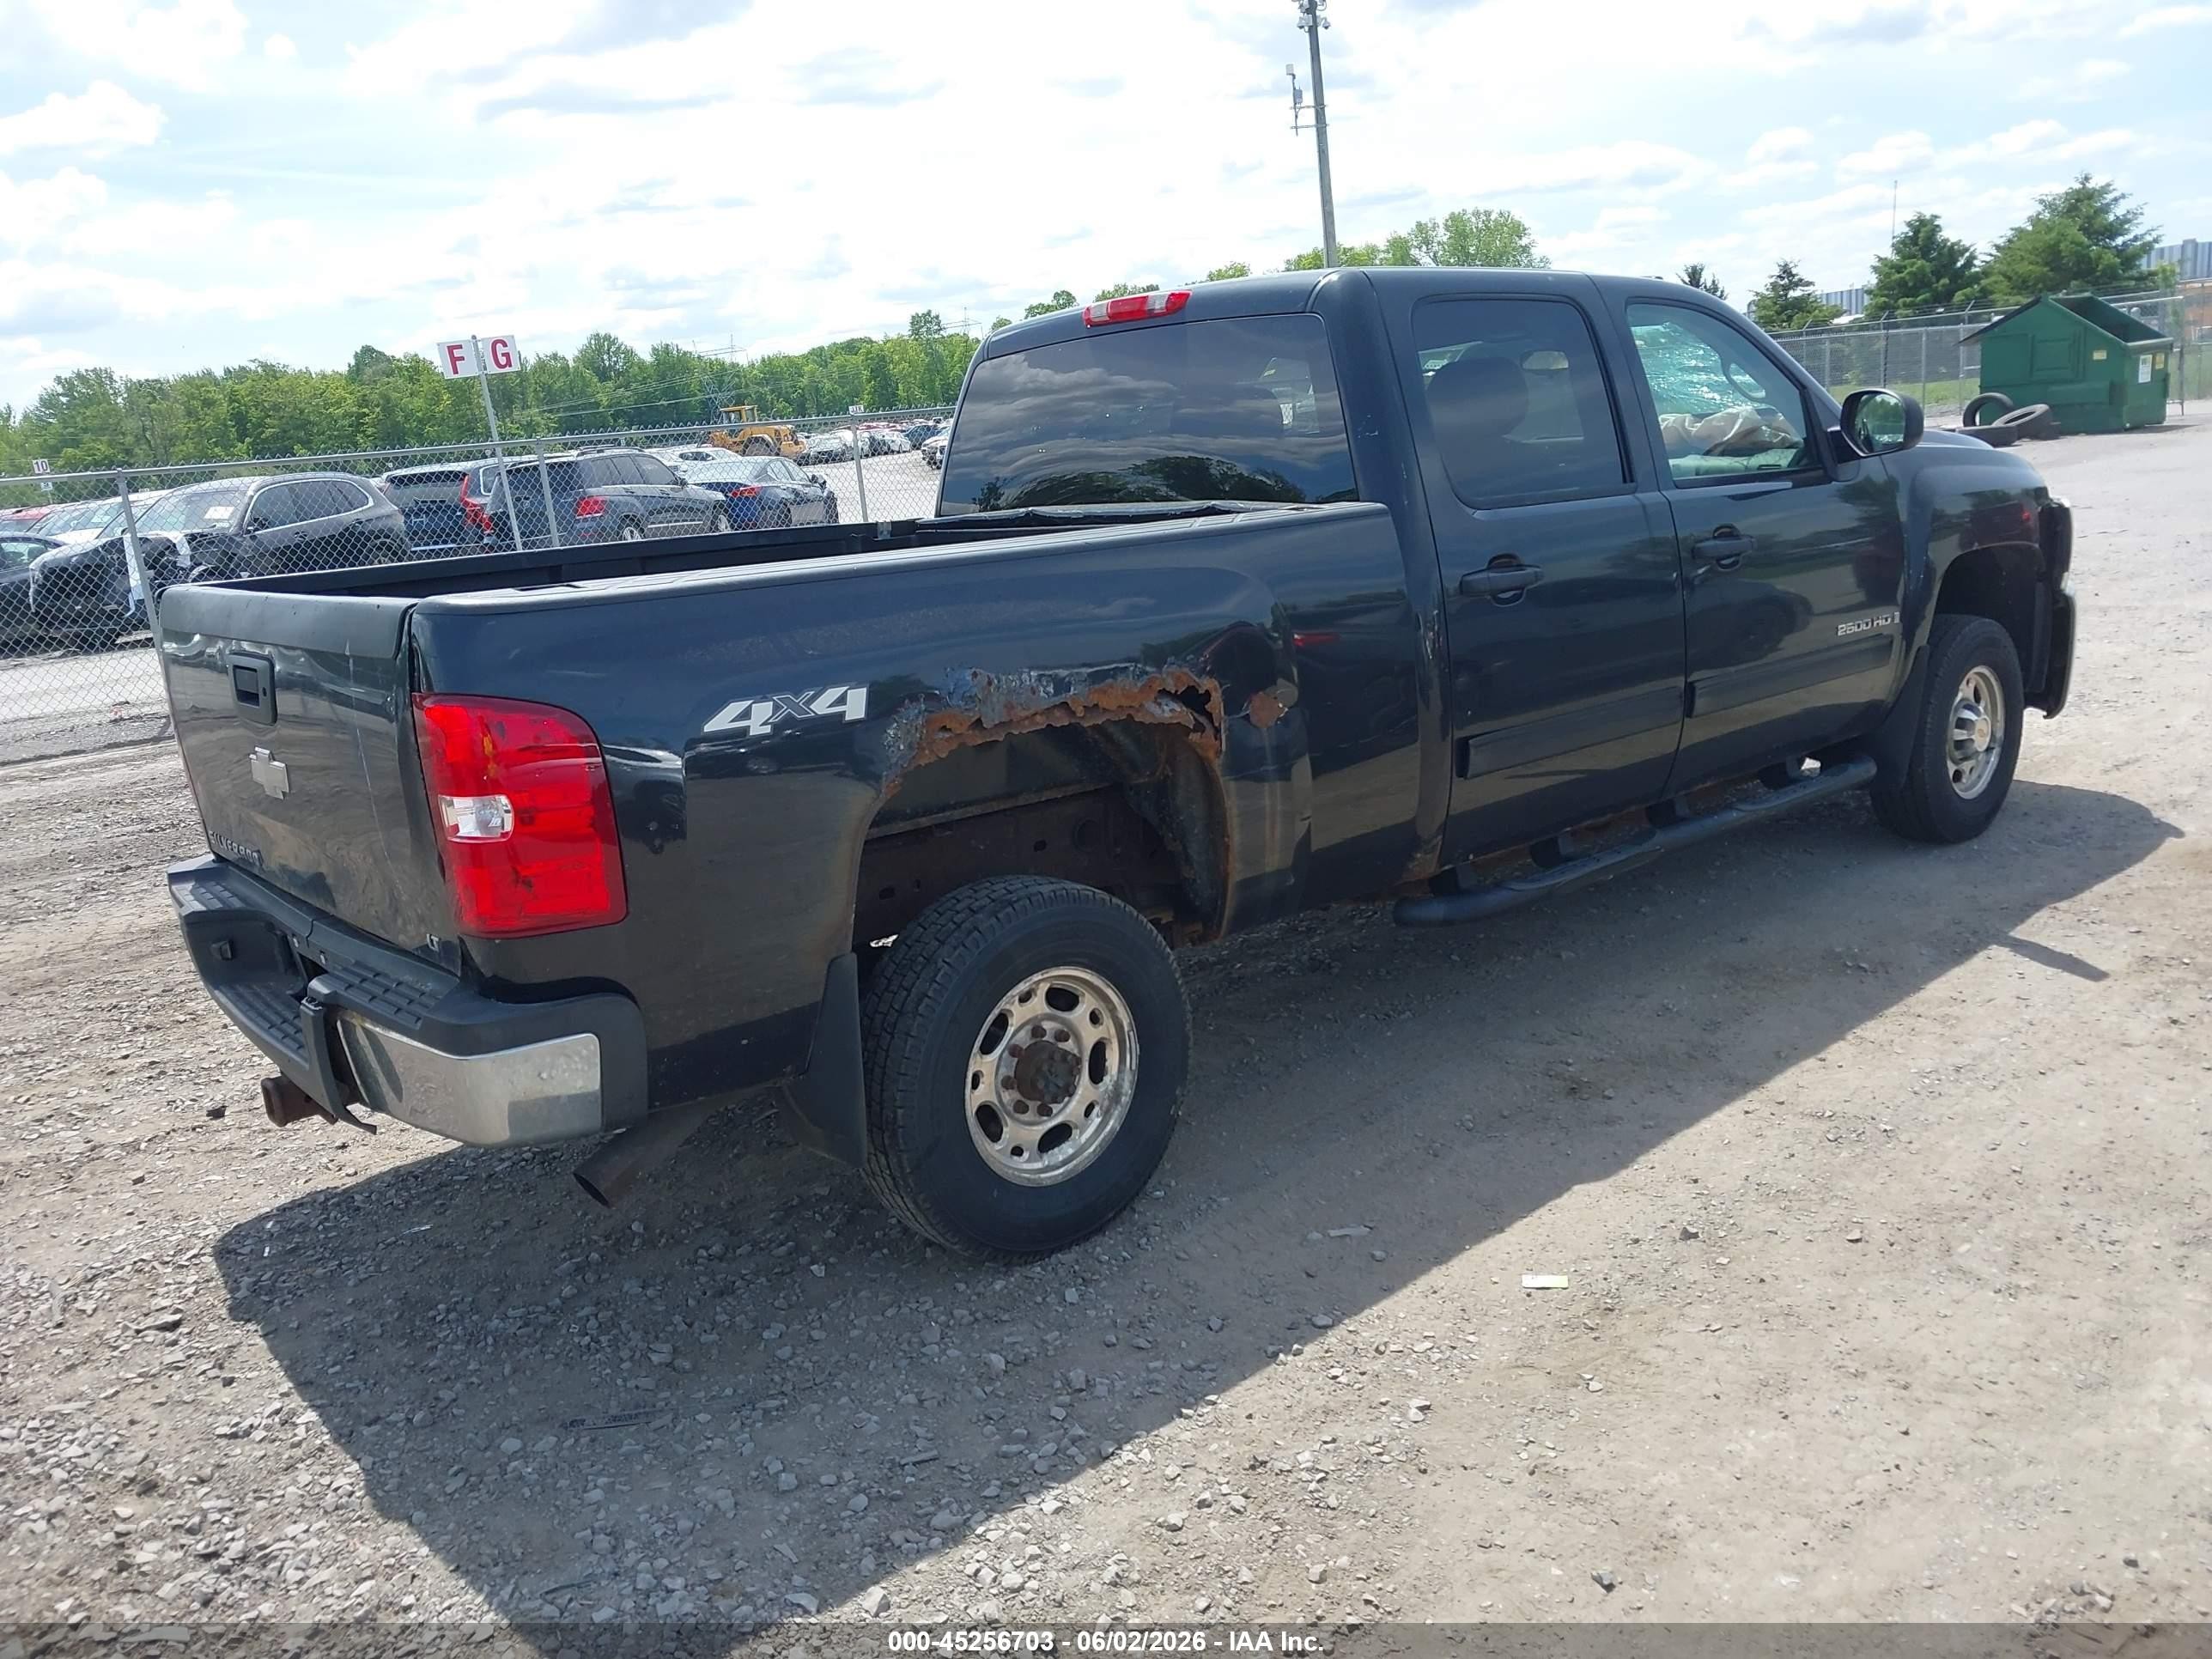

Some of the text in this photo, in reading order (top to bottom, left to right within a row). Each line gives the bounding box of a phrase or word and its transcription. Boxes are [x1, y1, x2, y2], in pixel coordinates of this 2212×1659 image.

[447, 344, 465, 374] F
[491, 338, 513, 369] G
[34, 460, 48, 471] 10
[1838, 614, 1891, 636] 2500 HD
[426, 933, 439, 952] LT
